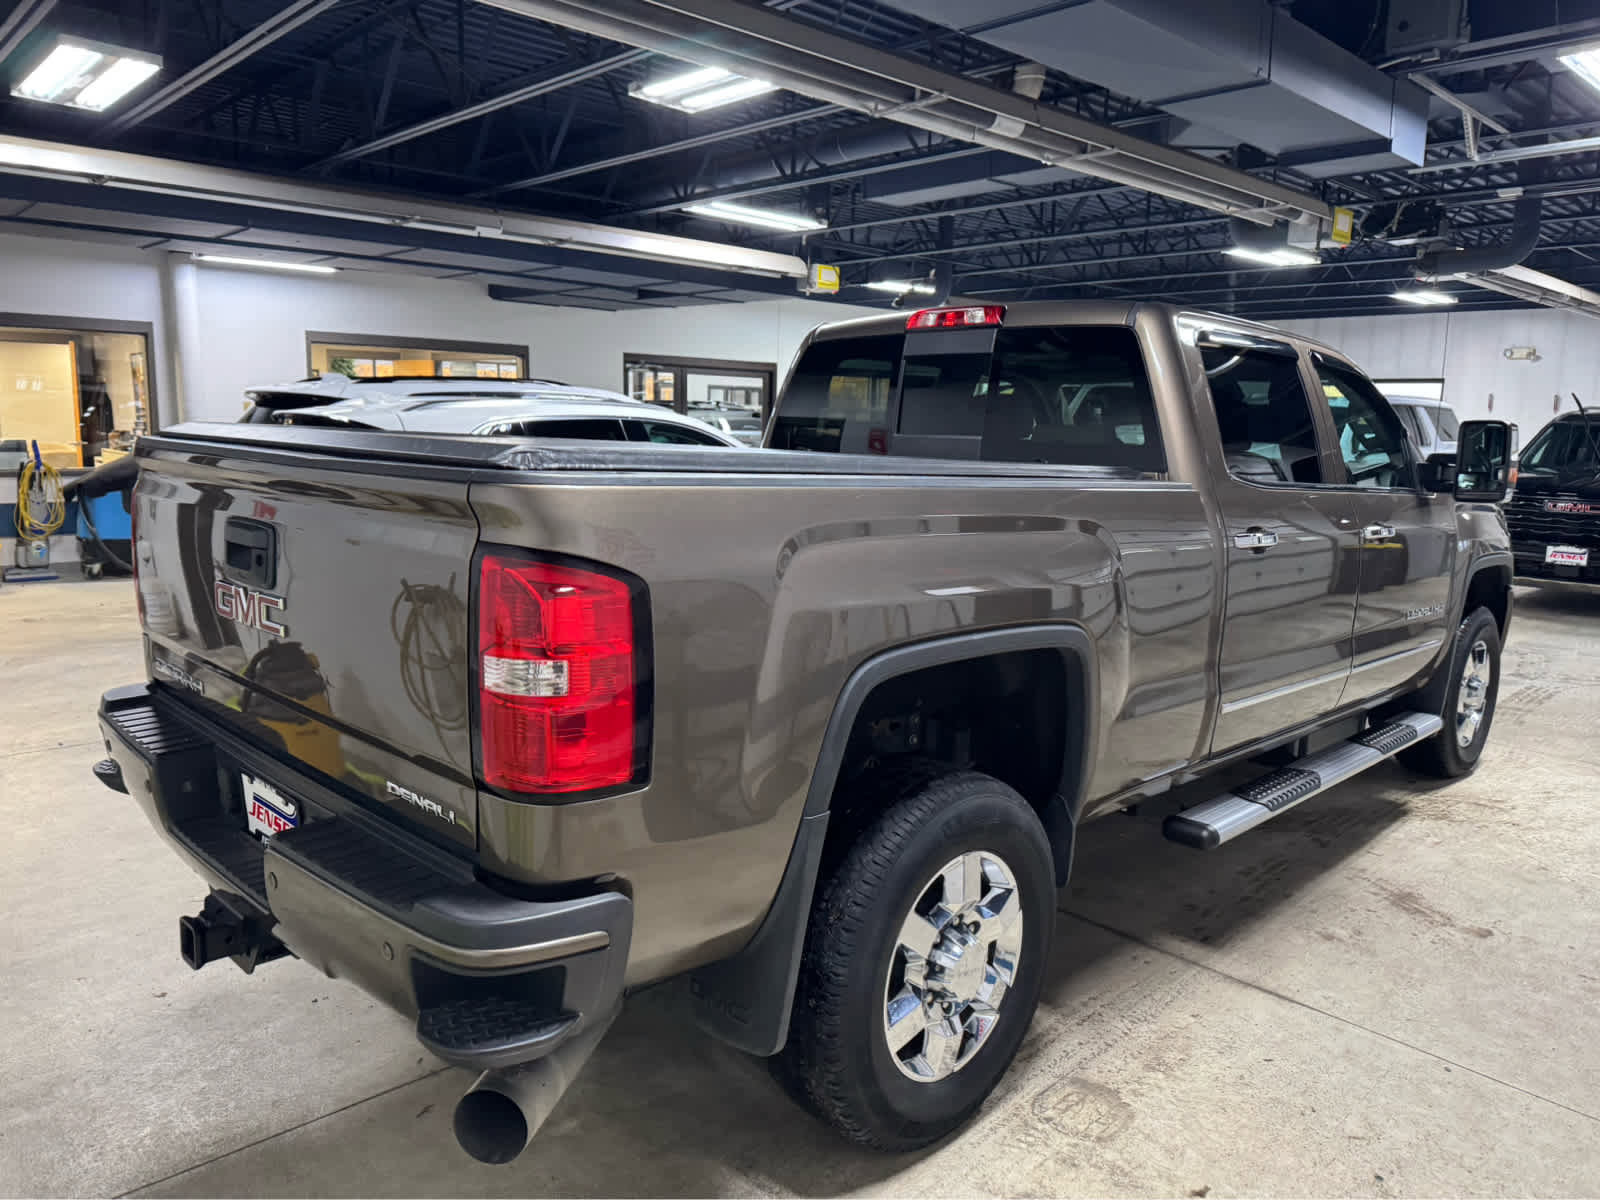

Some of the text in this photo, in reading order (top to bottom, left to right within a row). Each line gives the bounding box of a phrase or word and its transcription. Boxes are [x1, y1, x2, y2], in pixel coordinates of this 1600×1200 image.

[214, 581, 285, 639] GMC
[249, 801, 290, 833] JENSE
[386, 780, 455, 825] DENALI
